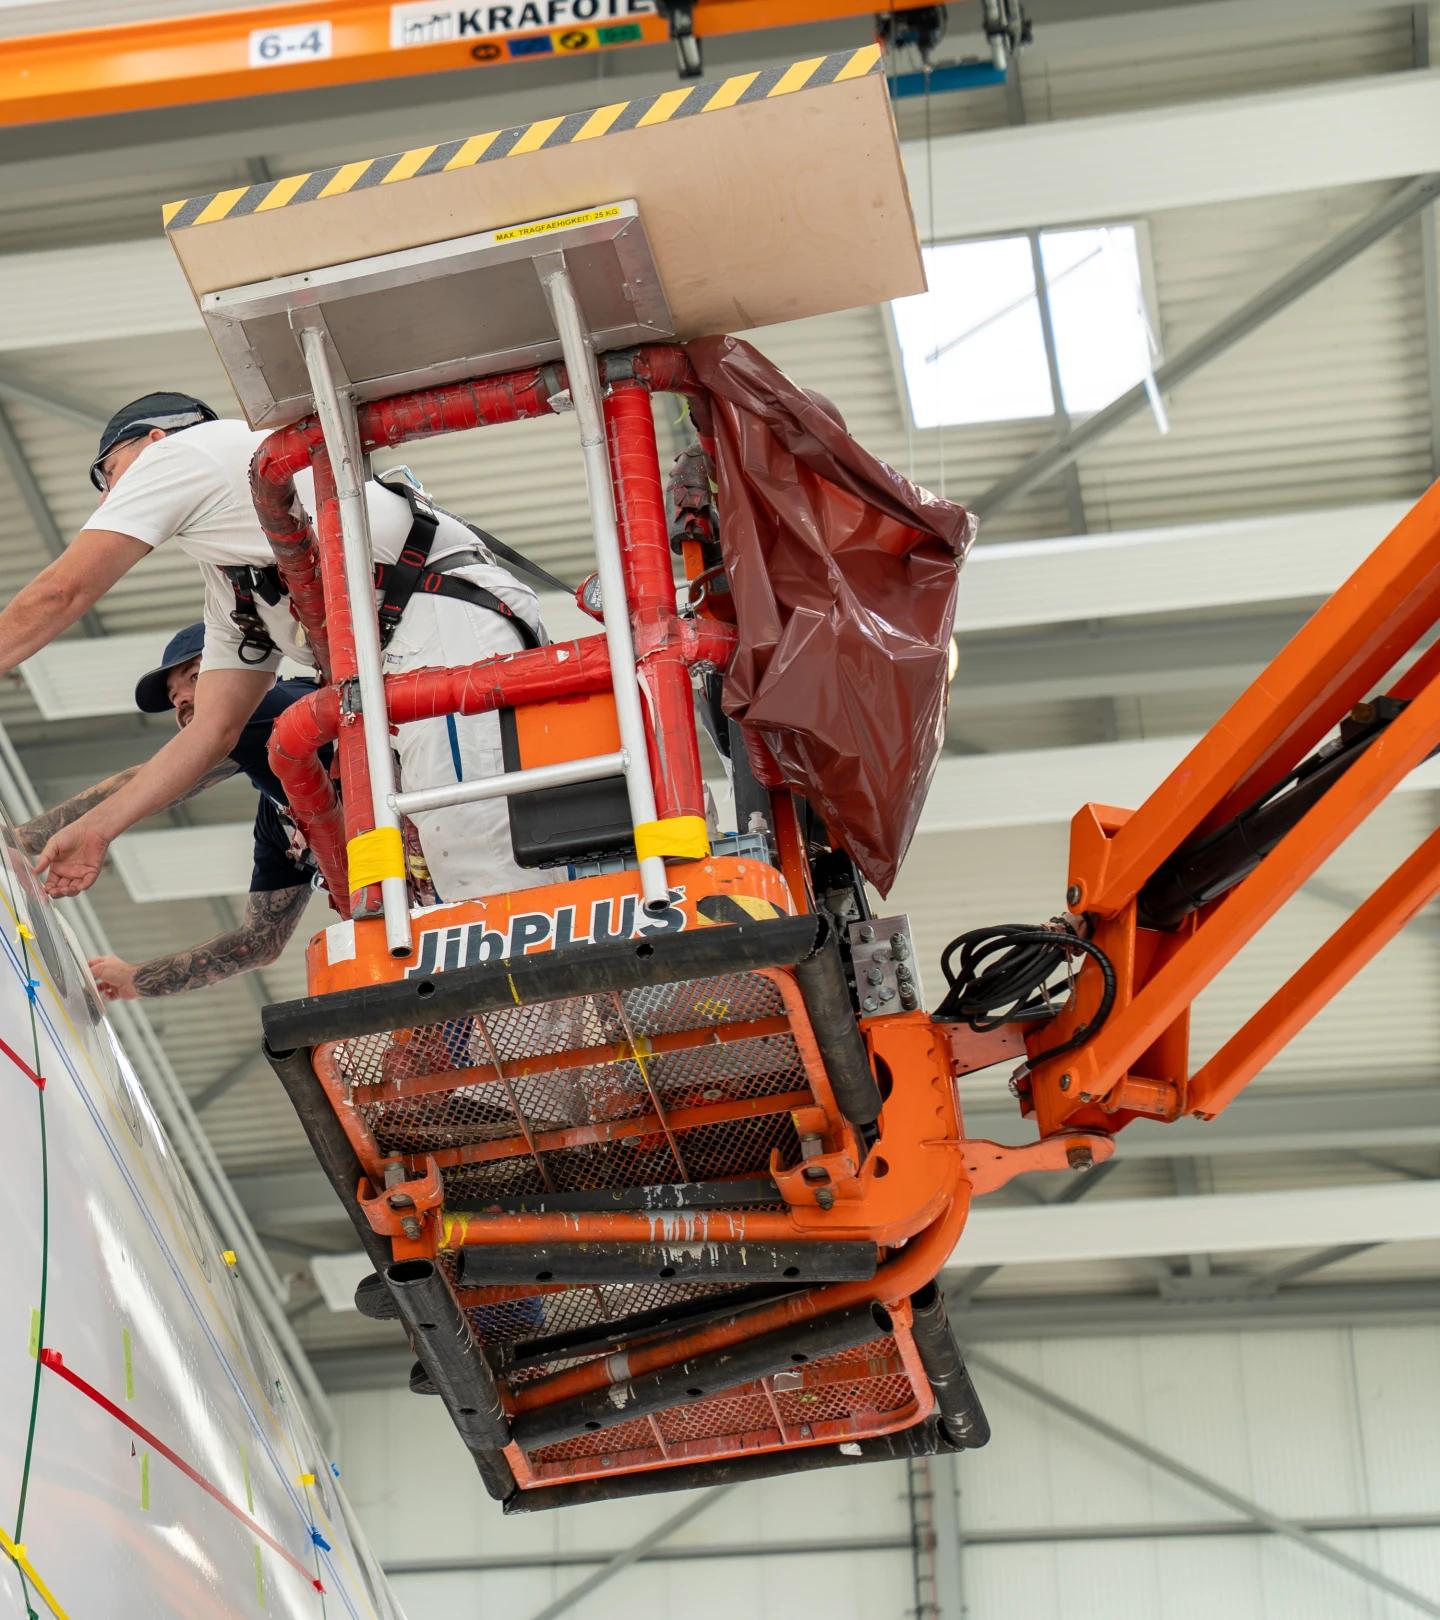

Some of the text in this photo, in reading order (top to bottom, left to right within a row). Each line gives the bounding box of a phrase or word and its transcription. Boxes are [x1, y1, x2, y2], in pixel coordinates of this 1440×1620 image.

[259, 29, 323, 60] 6-4
[519, 214, 592, 236] TRAGFAEHIGKEIT:
[594, 211, 604, 219] 25
[605, 208, 618, 216] KG
